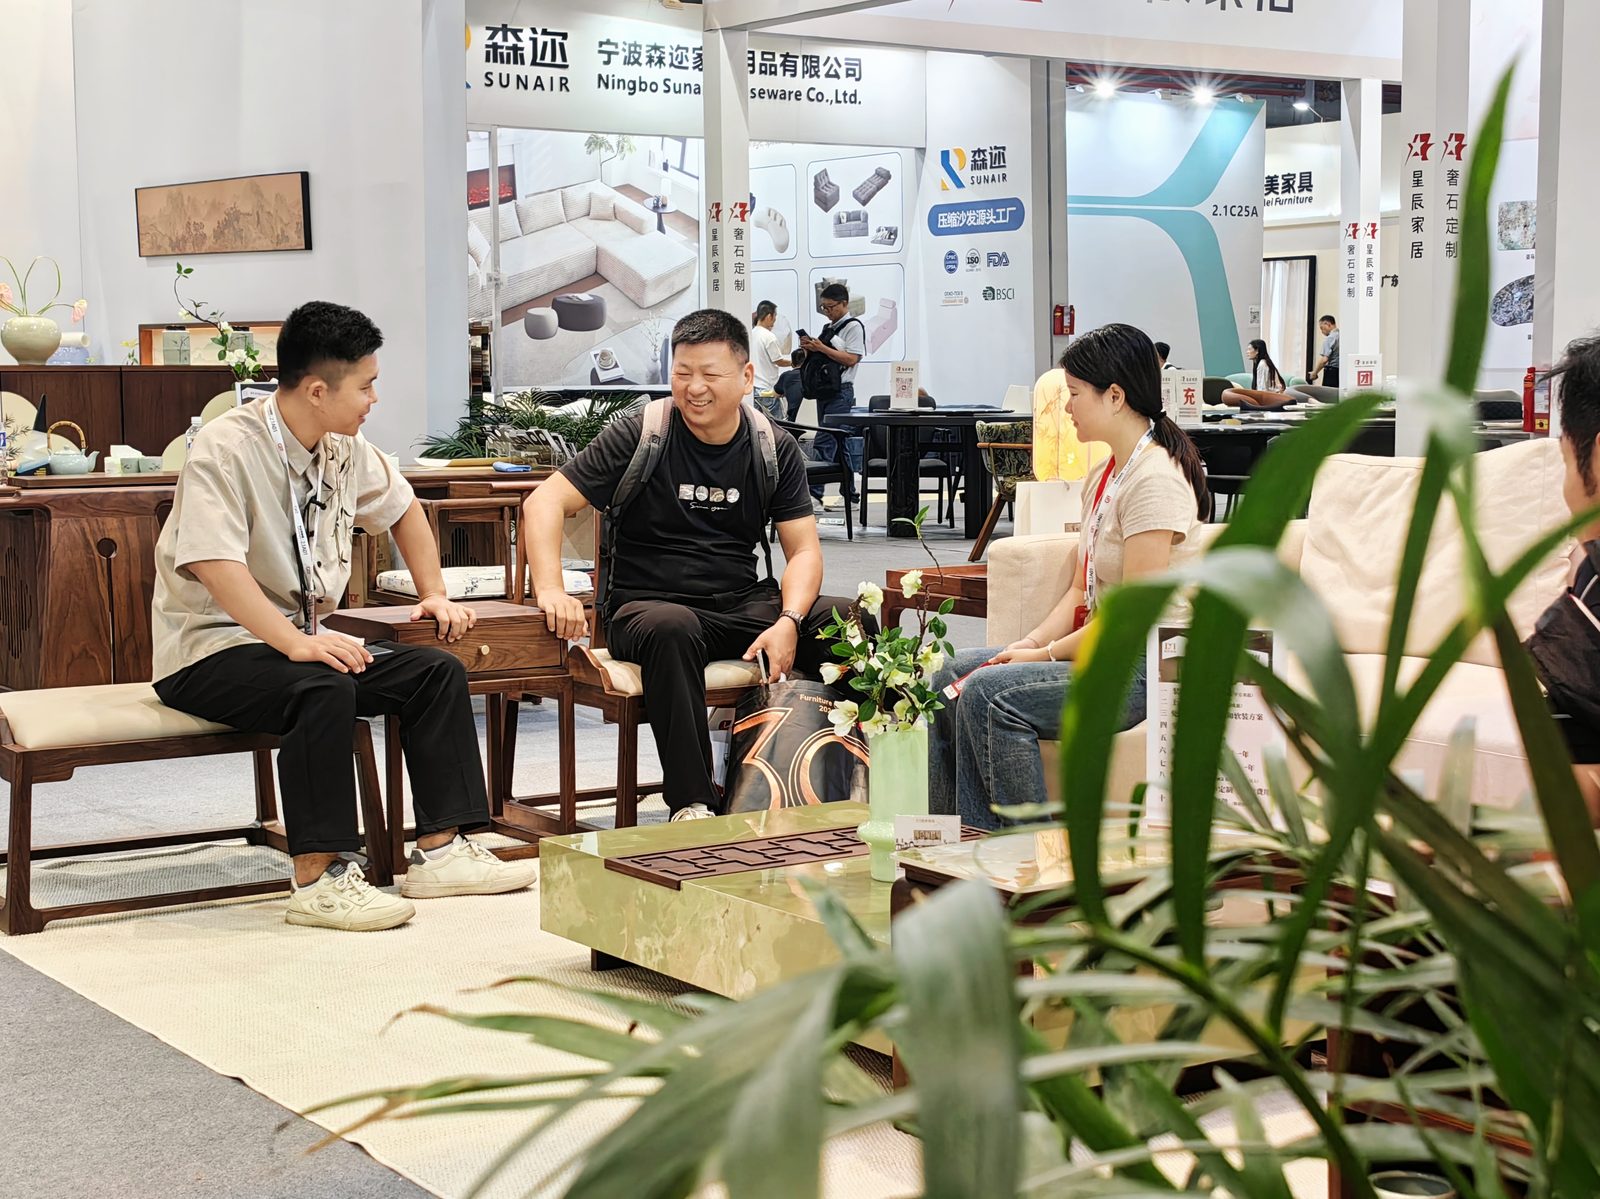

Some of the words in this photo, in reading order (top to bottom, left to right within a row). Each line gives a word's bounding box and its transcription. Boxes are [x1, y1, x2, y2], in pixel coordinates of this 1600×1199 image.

[485, 24, 569, 69] 森迩
[484, 71, 570, 92] SUNAIR
[597, 73, 659, 96] Ningbo
[663, 78, 701, 95] Suna
[750, 87, 802, 101] seware
[806, 86, 862, 105] Co.,Ltd.
[970, 145, 1007, 171] 森迩
[970, 172, 1008, 186] SUNAIR
[1264, 171, 1313, 196] 美家具
[1212, 204, 1259, 218] 2.1C25A
[1274, 195, 1313, 206] Furniture
[937, 206, 1017, 229] 压缩沙发源头工厂
[1410, 170, 1424, 259] 星辰家居
[1445, 169, 1459, 258] 奢石定制
[711, 228, 720, 292] 星辰家居
[733, 227, 745, 292] 奢石定制
[967, 256, 980, 264] ISO
[986, 251, 1010, 268] FDA
[996, 288, 1015, 301] BSCI
[1183, 387, 1196, 406] 充
[799, 693, 833, 707] Furniture
[818, 705, 833, 714] 202
